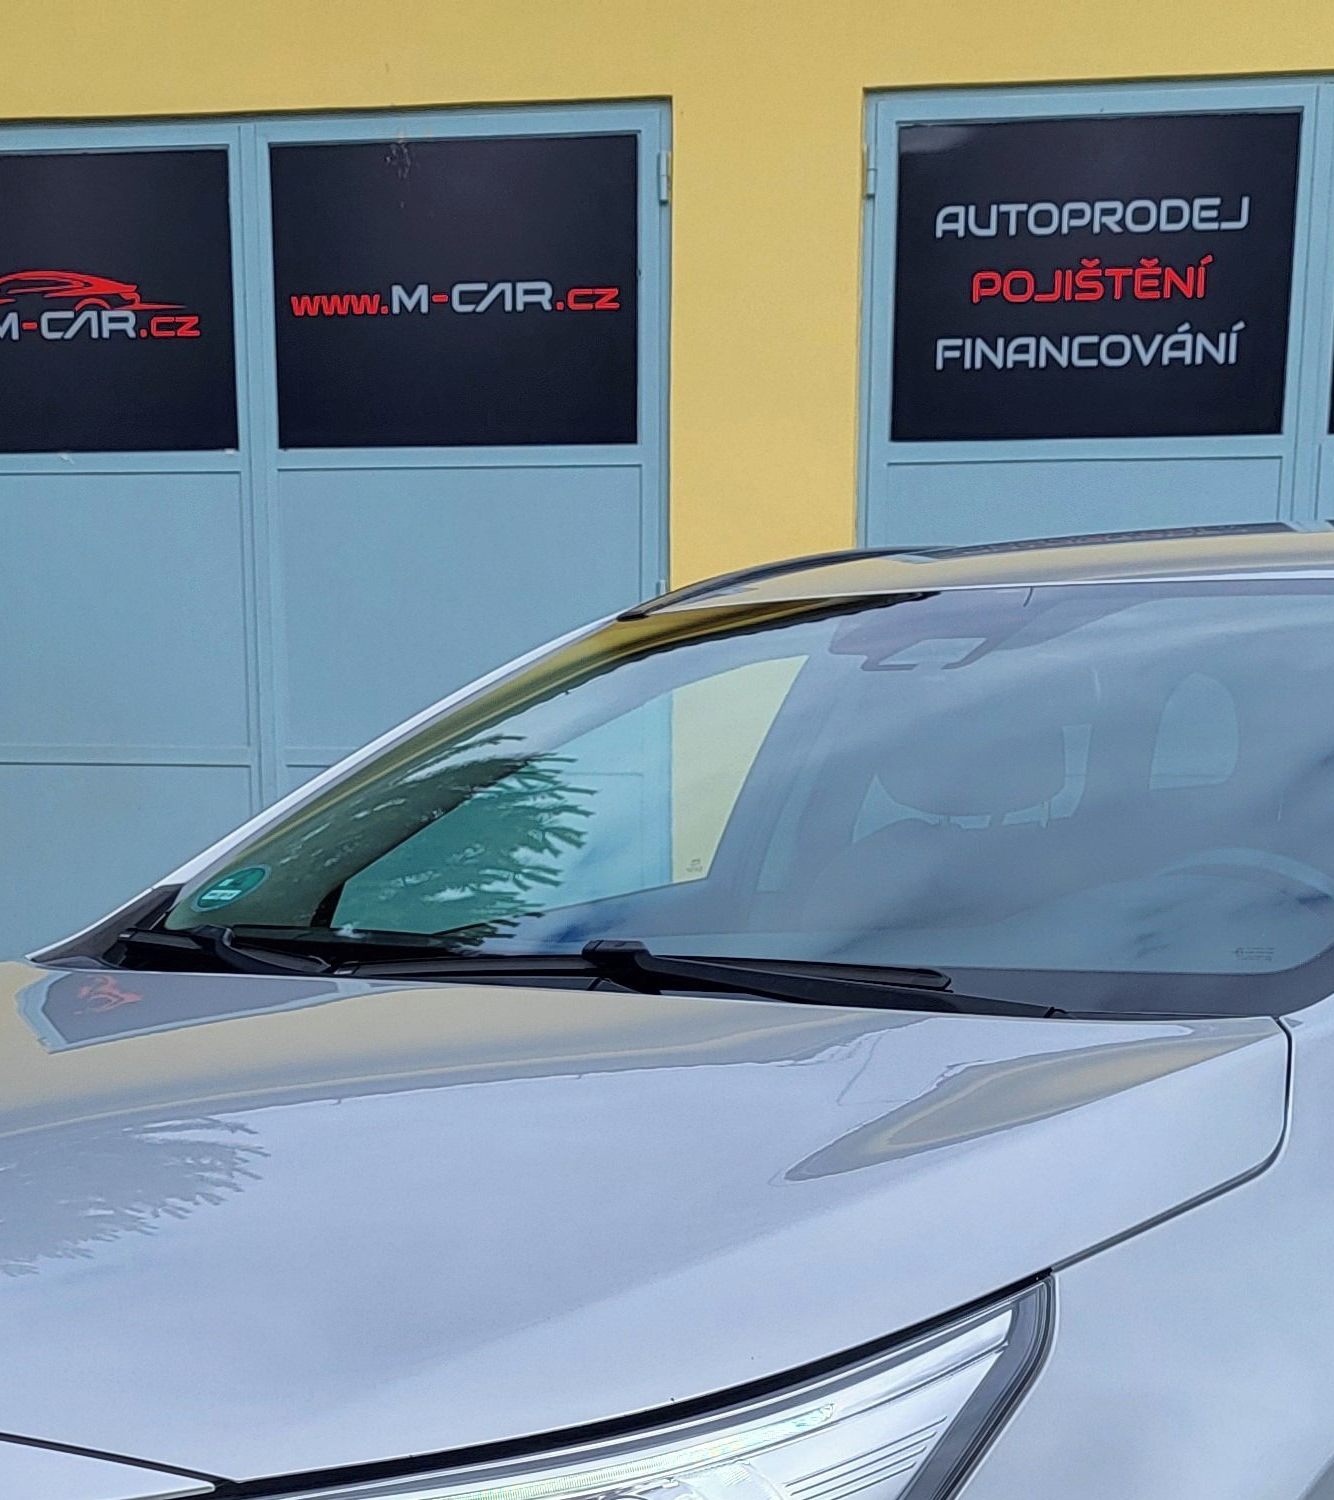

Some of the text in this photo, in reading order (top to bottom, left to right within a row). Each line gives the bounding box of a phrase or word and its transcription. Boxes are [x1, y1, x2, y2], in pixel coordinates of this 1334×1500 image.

[934, 196, 1250, 239] AUTOPRODEJ
[970, 255, 1214, 304] POJIŠTĚNÍ
[935, 321, 1246, 371] FINANCOVÁNÍ
